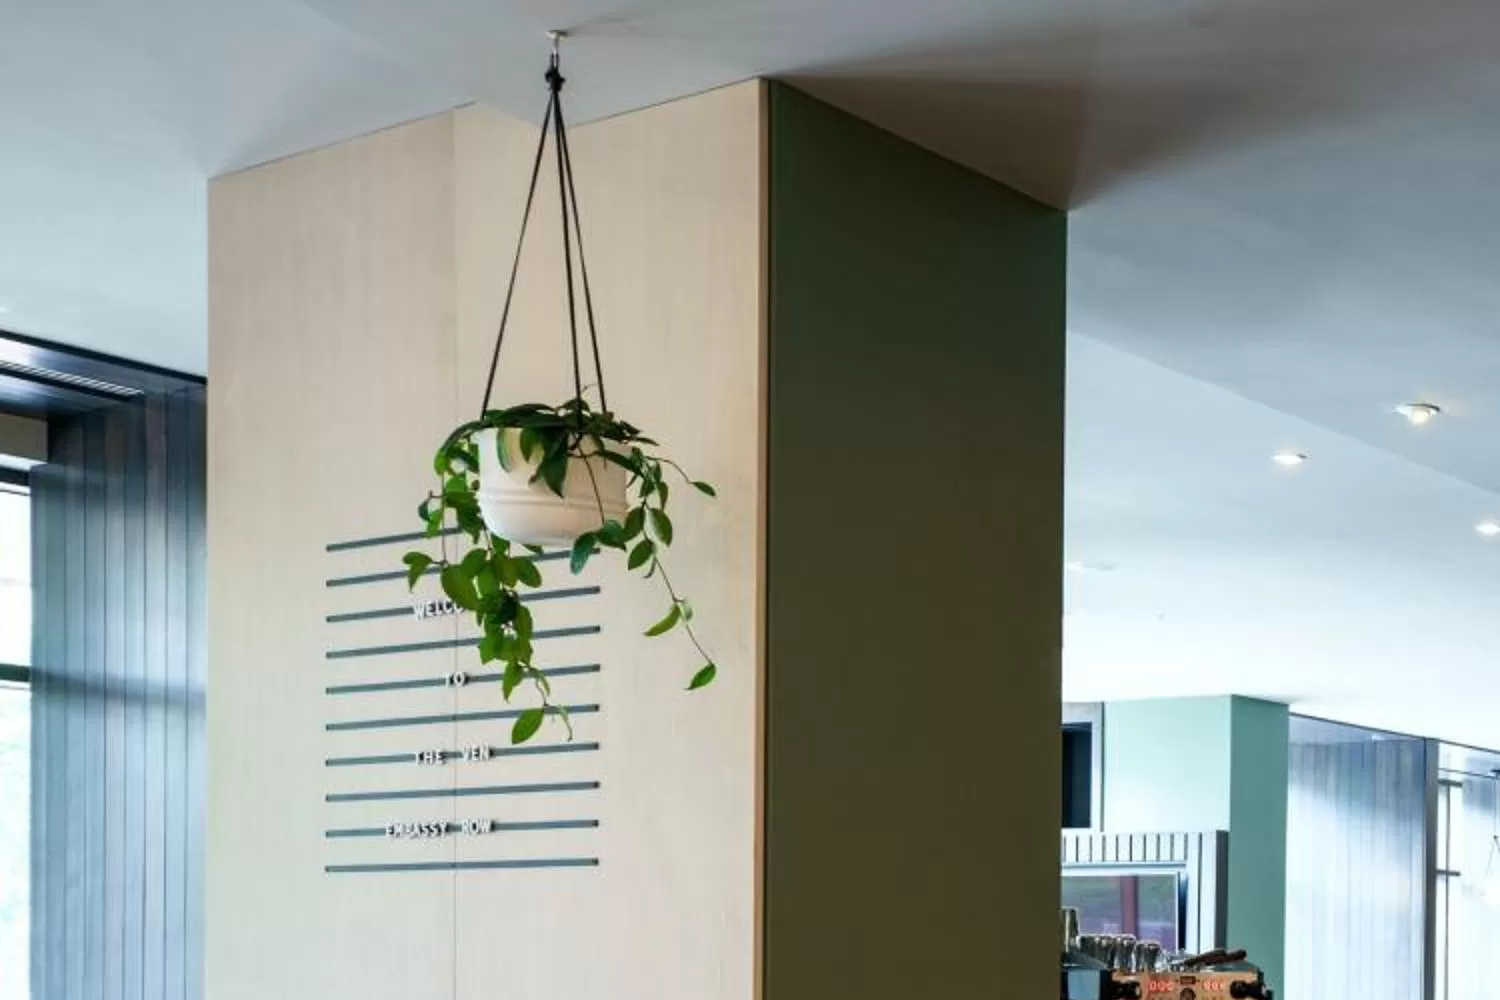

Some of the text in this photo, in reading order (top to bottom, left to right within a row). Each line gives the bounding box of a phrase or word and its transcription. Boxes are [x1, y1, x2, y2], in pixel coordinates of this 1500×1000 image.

[413, 599, 465, 620] WELCO
[443, 671, 467, 688] TO
[412, 748, 446, 767] THE
[386, 817, 492, 839] EMBASSY ROW
